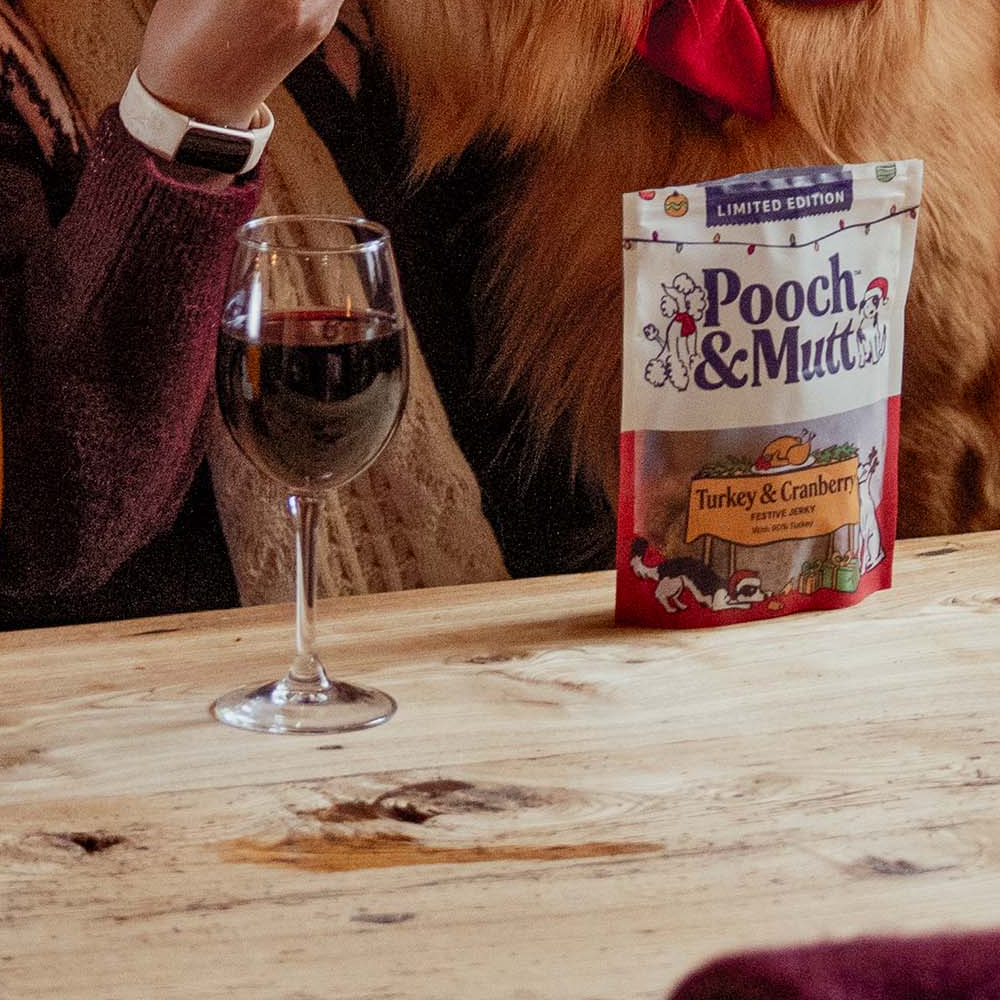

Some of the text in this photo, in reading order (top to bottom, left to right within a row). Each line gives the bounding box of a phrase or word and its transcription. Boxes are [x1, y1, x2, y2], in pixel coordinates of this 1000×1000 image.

[717, 190, 845, 217] LIMITED EDITION
[702, 252, 858, 327] Pooch
[695, 474, 855, 512] Turkey & Cranberry
[750, 504, 817, 521] FESTIVE JERKY
